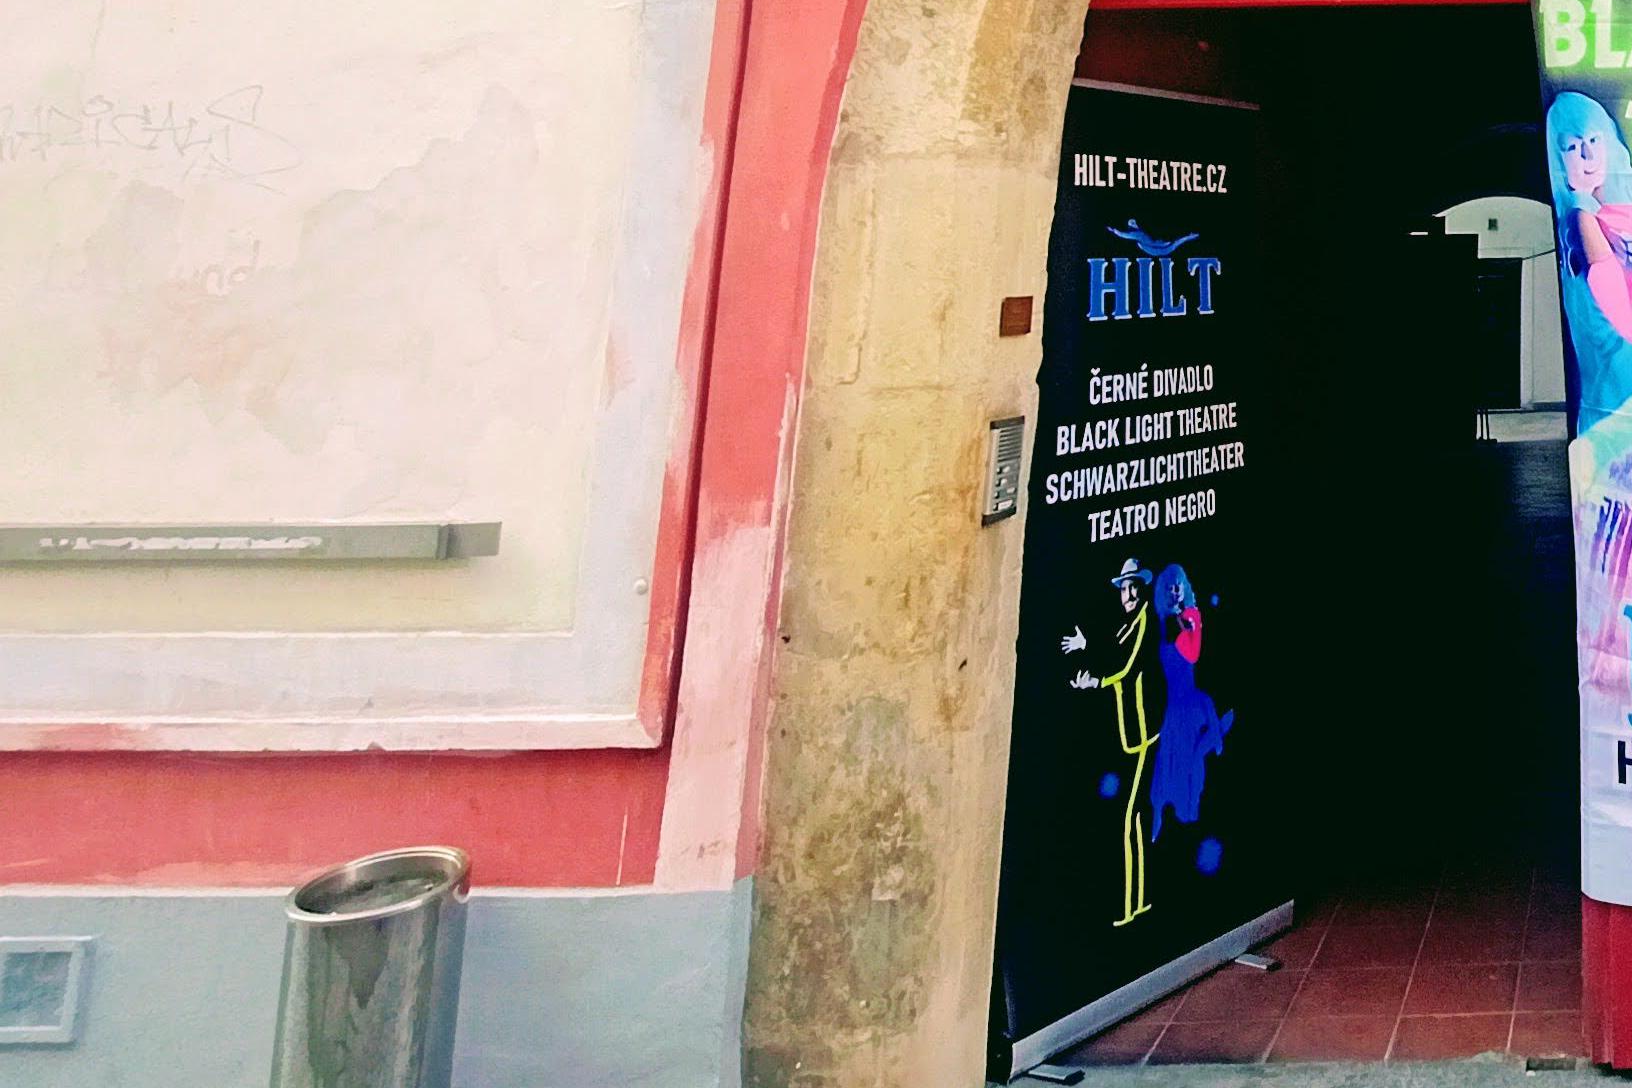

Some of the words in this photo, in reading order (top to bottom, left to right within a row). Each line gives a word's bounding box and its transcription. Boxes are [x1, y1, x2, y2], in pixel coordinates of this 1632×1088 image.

[1073, 153, 1228, 194] HILT-THEATRE.CZ
[1086, 257, 1221, 322] HILT
[1089, 363, 1149, 405] ČERNÉ
[1153, 364, 1214, 393] DIVADLO
[1056, 418, 1119, 456] BLACK
[1124, 410, 1174, 446] LIGHT
[1177, 402, 1237, 435] THEATRE
[1045, 442, 1245, 505] SCHWARZLICHTTHEATER
[1088, 500, 1160, 543] TEATRO
[1164, 488, 1217, 527] NEGRO
